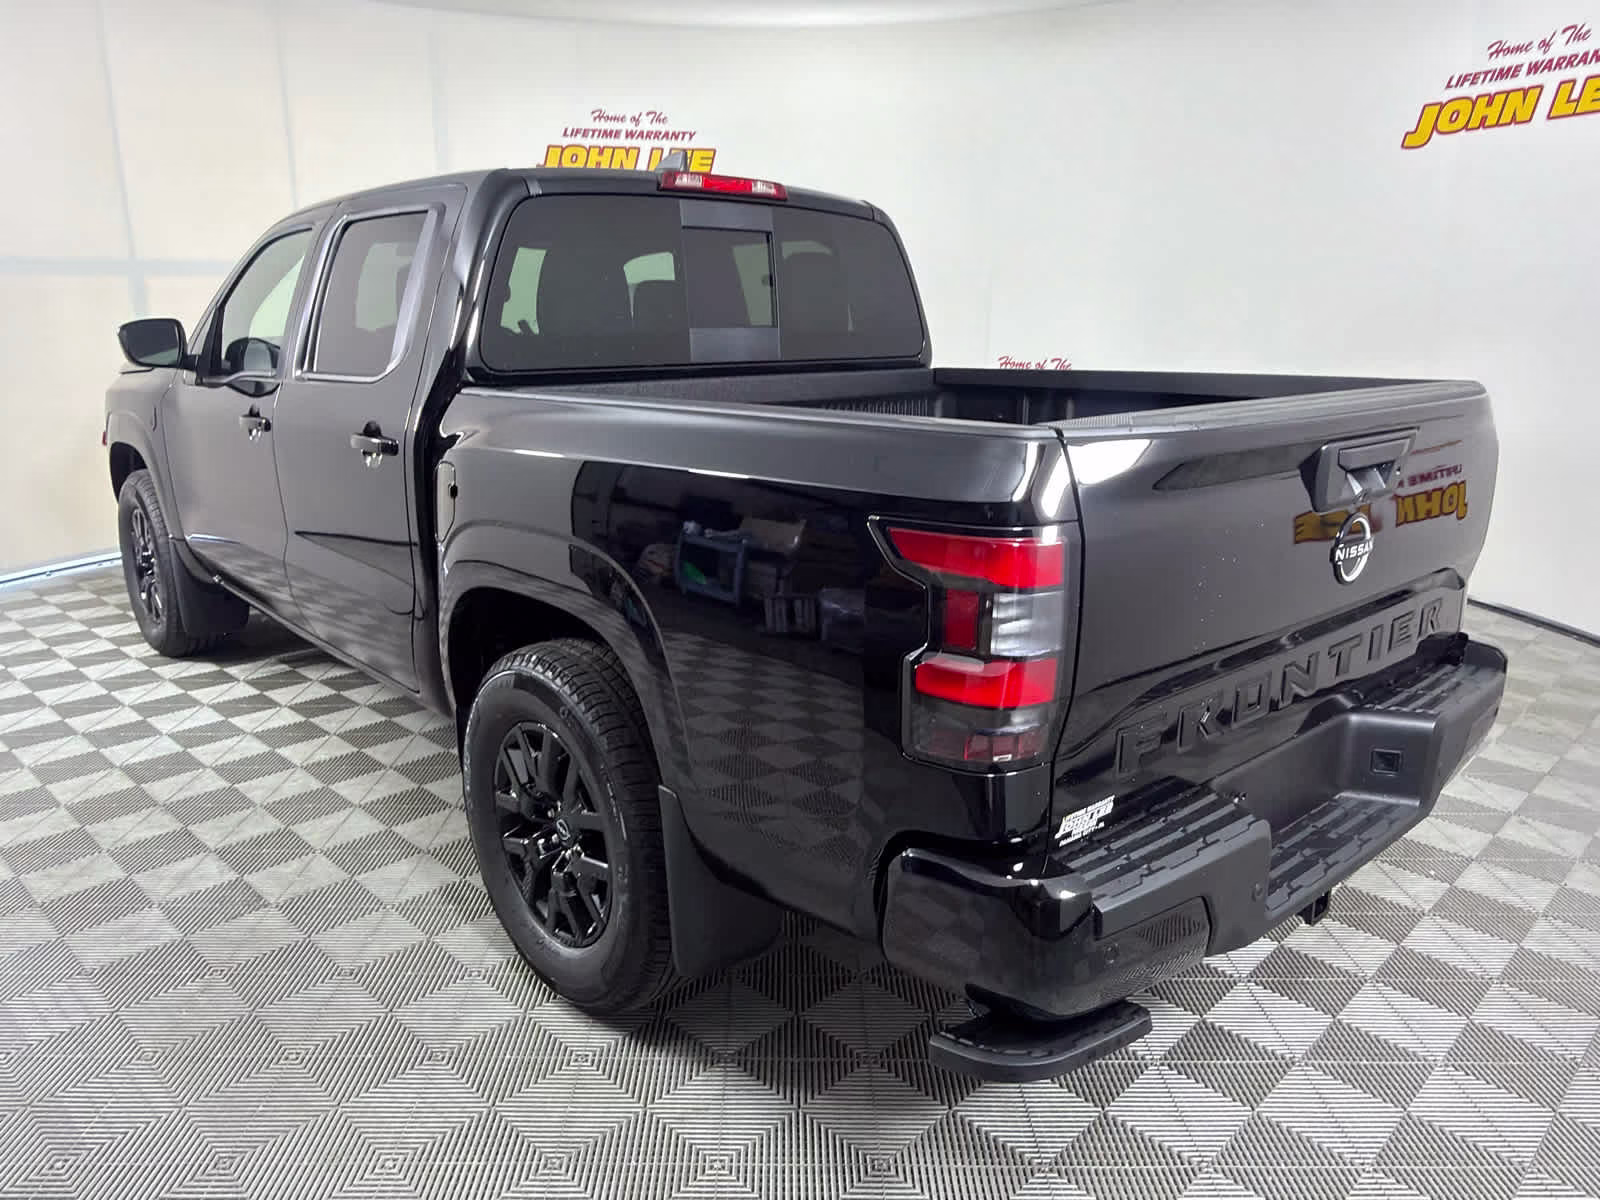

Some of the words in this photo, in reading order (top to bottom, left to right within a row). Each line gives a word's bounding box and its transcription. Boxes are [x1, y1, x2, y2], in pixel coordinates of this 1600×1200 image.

[1487, 39, 1533, 60] Home
[1537, 30, 1557, 54] of
[1561, 22, 1591, 46] The
[1444, 63, 1523, 89] LIFETIME
[590, 109, 627, 124] Home
[629, 112, 643, 127] of
[646, 111, 669, 125] The
[1401, 84, 1544, 149] JOHN
[562, 127, 622, 139] LIFETIME
[624, 129, 697, 142] WARRANTY
[536, 144, 641, 169] JOHN
[998, 356, 1032, 369] Home
[1051, 357, 1072, 370] The
[1335, 540, 1374, 561] NISSAN
[1113, 597, 1443, 777] FRONTIER
